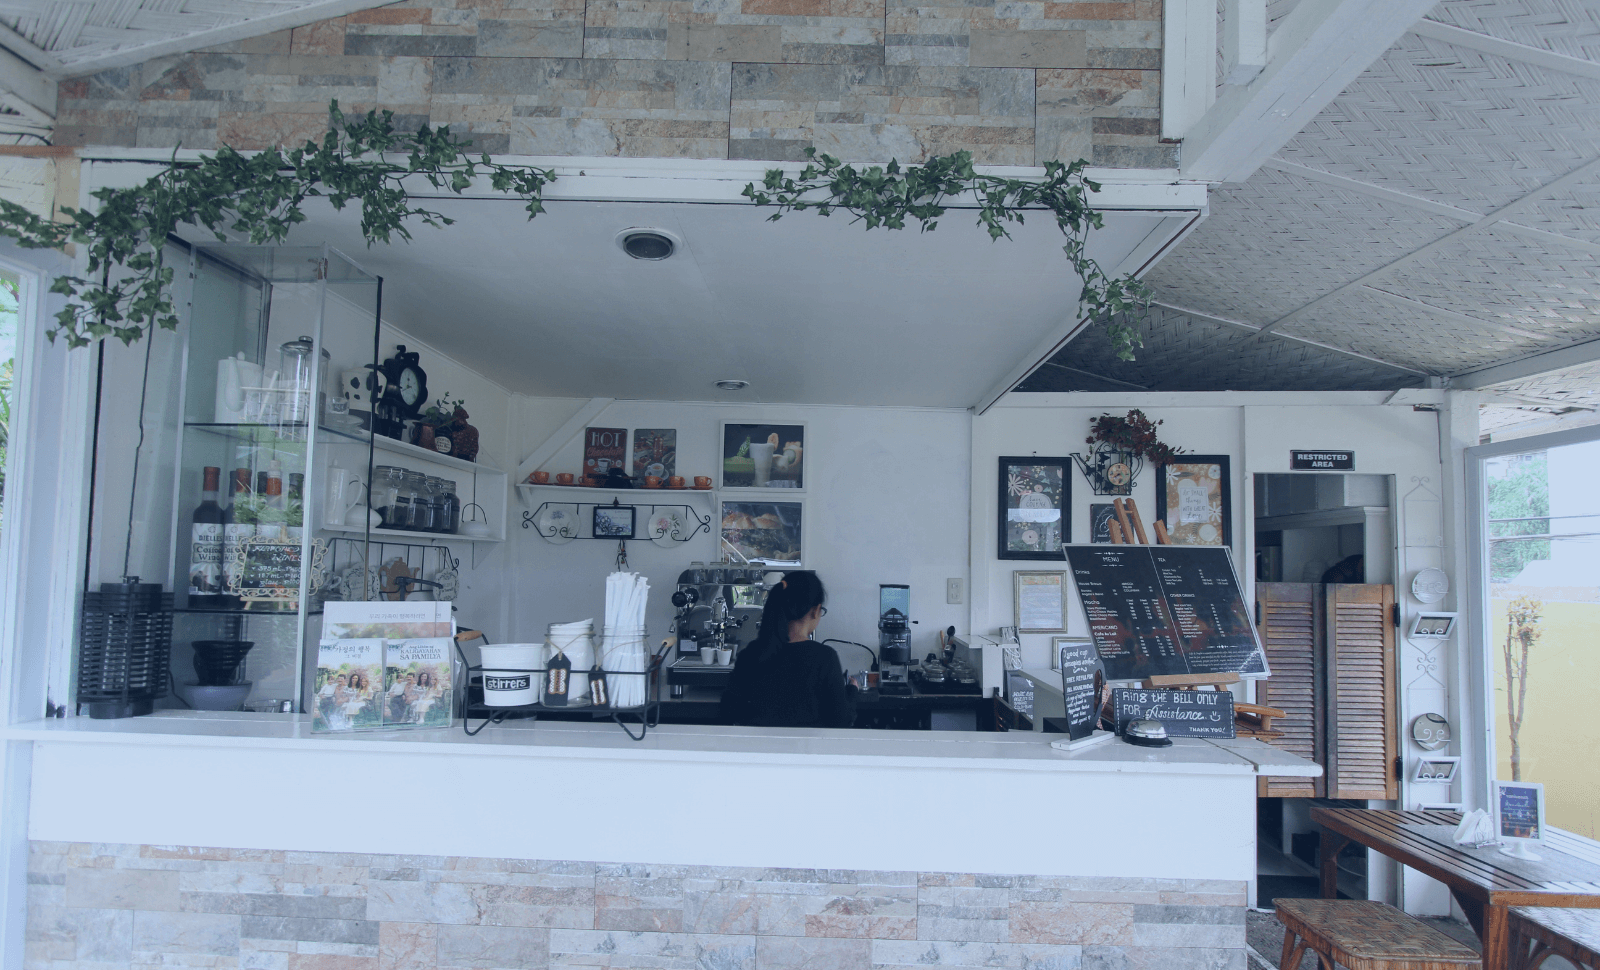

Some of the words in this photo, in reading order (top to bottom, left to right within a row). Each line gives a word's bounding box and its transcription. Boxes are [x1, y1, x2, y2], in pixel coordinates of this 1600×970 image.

[592, 432, 621, 447] HOT
[487, 679, 527, 689] stirrers
[1122, 691, 1147, 703] Ring
[1173, 693, 1193, 703] BELL
[1123, 704, 1140, 715] FOR
